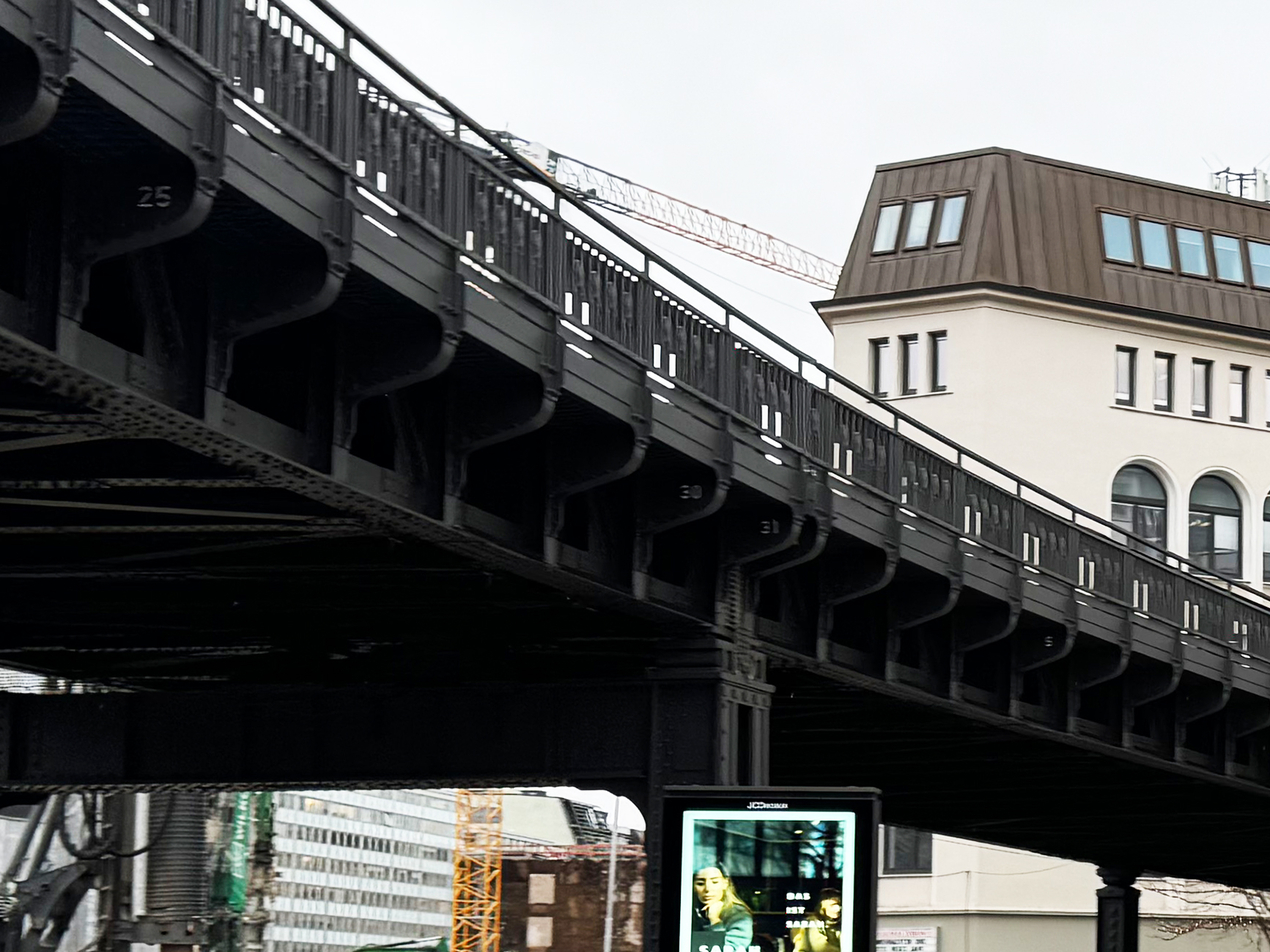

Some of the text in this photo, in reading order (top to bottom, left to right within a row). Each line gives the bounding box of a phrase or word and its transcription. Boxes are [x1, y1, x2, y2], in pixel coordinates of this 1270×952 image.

[136, 185, 172, 208] 25
[679, 485, 703, 500] 30
[760, 518, 780, 534] 31
[786, 892, 811, 901] DAS
